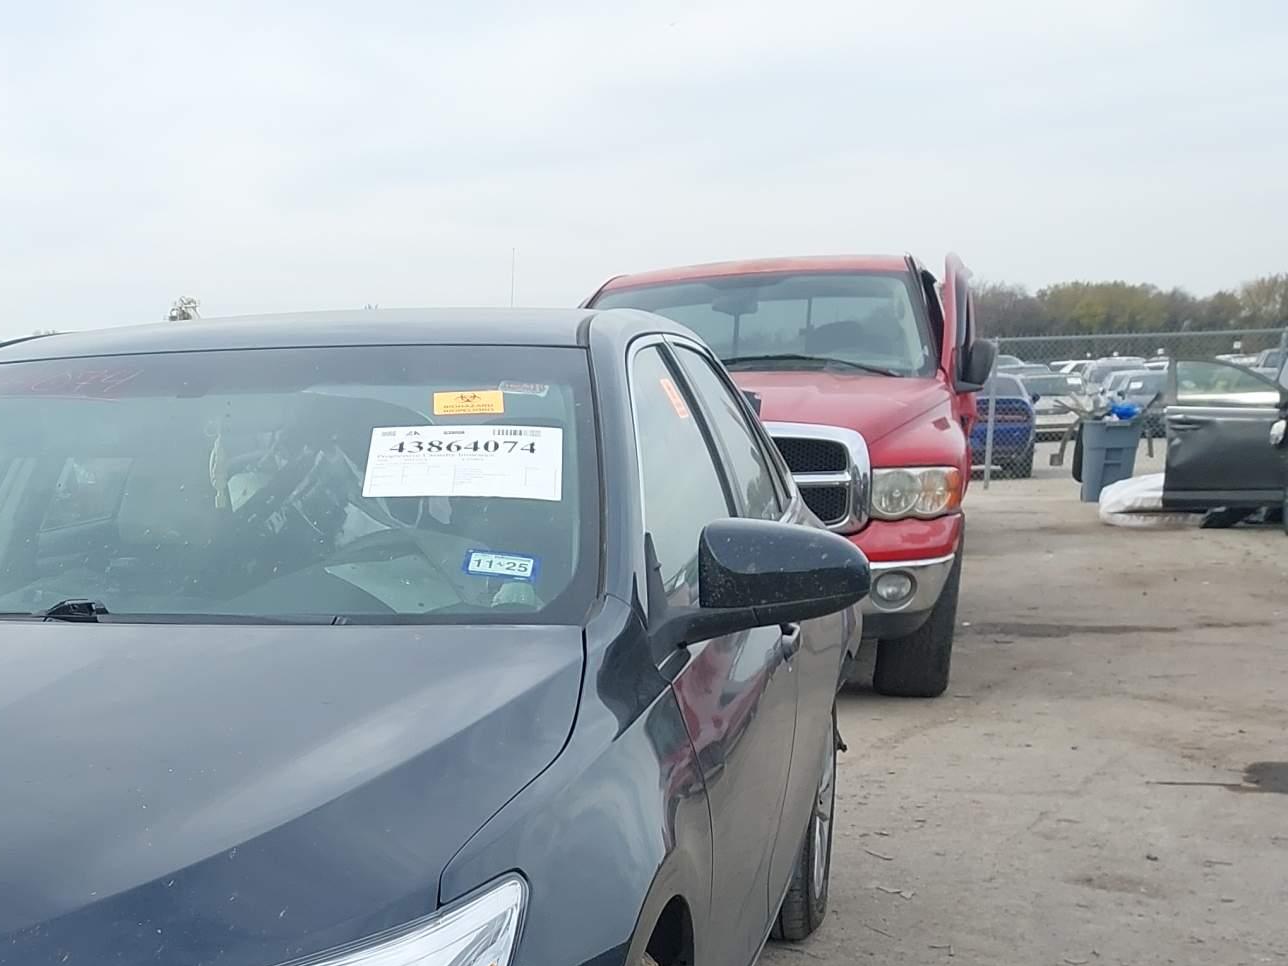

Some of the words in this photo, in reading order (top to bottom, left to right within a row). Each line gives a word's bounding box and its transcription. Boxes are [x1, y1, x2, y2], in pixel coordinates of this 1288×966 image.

[389, 439, 536, 454] 43864074
[474, 558, 493, 569] 11
[505, 561, 529, 573] 25
